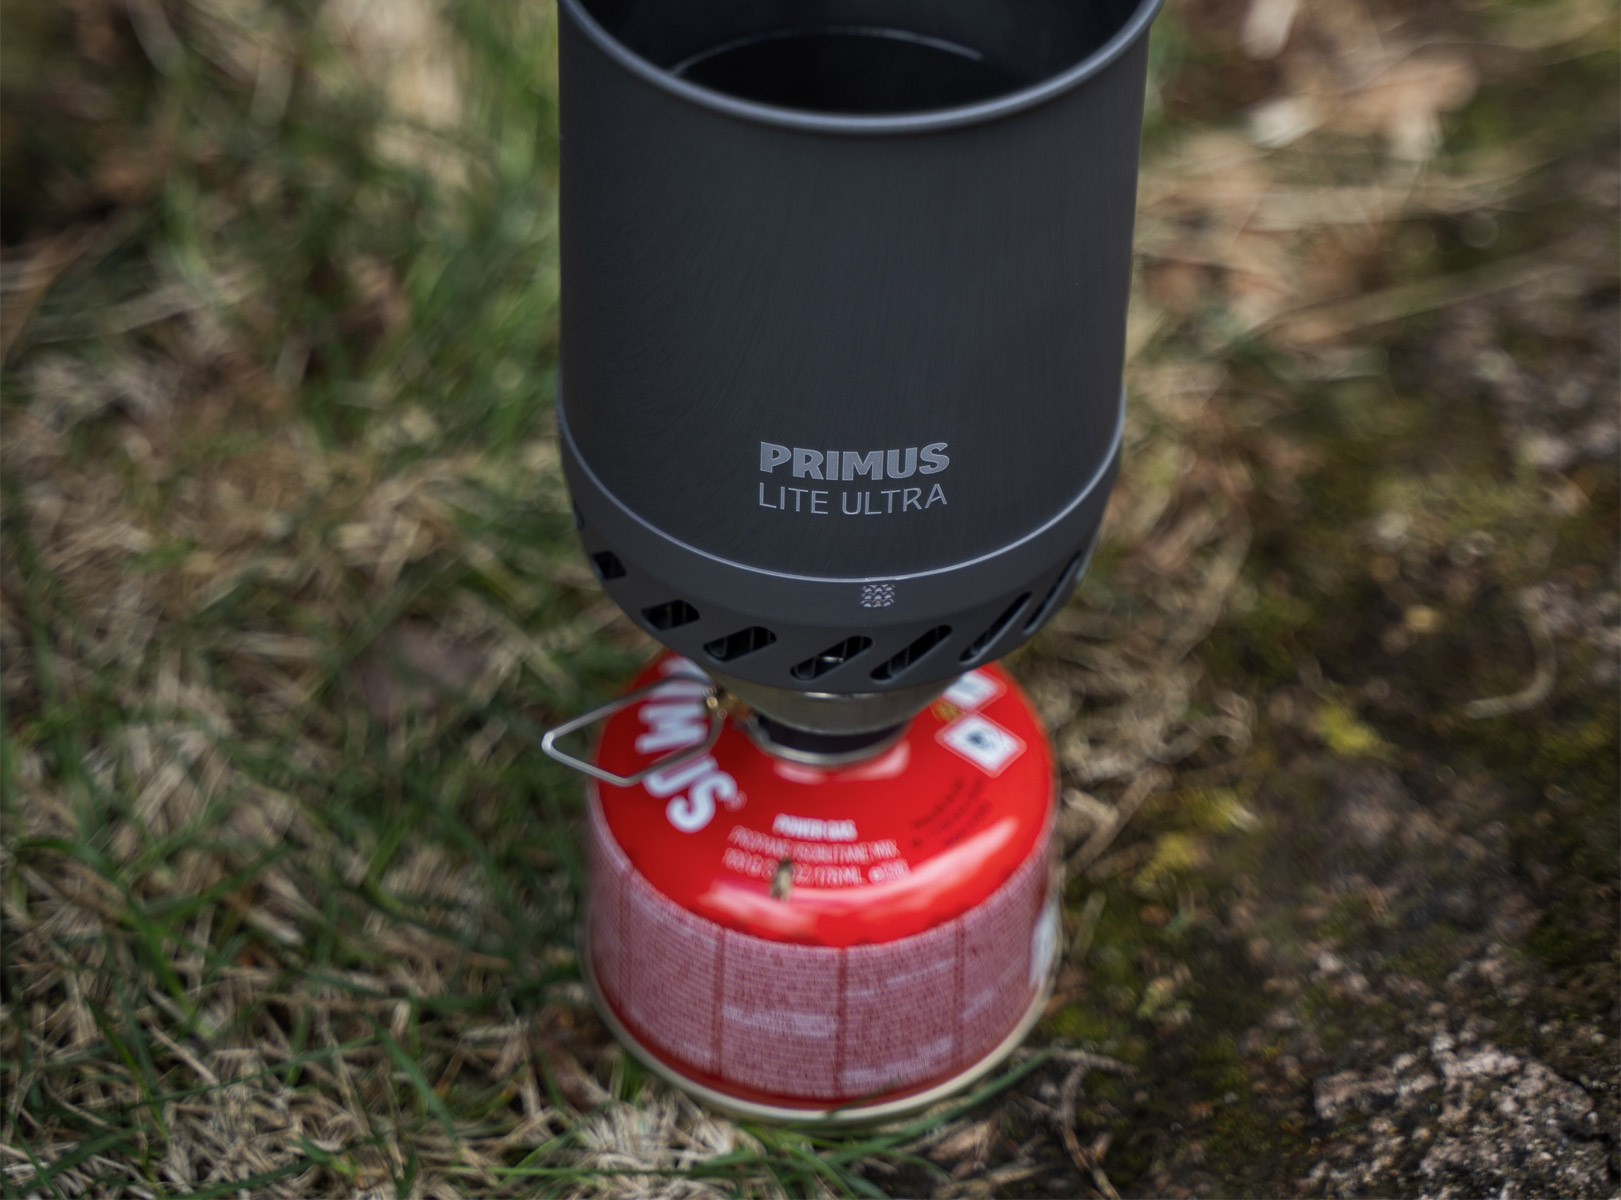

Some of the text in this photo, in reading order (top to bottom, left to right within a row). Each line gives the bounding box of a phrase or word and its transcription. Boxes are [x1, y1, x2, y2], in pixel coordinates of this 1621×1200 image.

[760, 441, 950, 481] PRIMUS
[759, 482, 948, 515] LITE ULTRA
